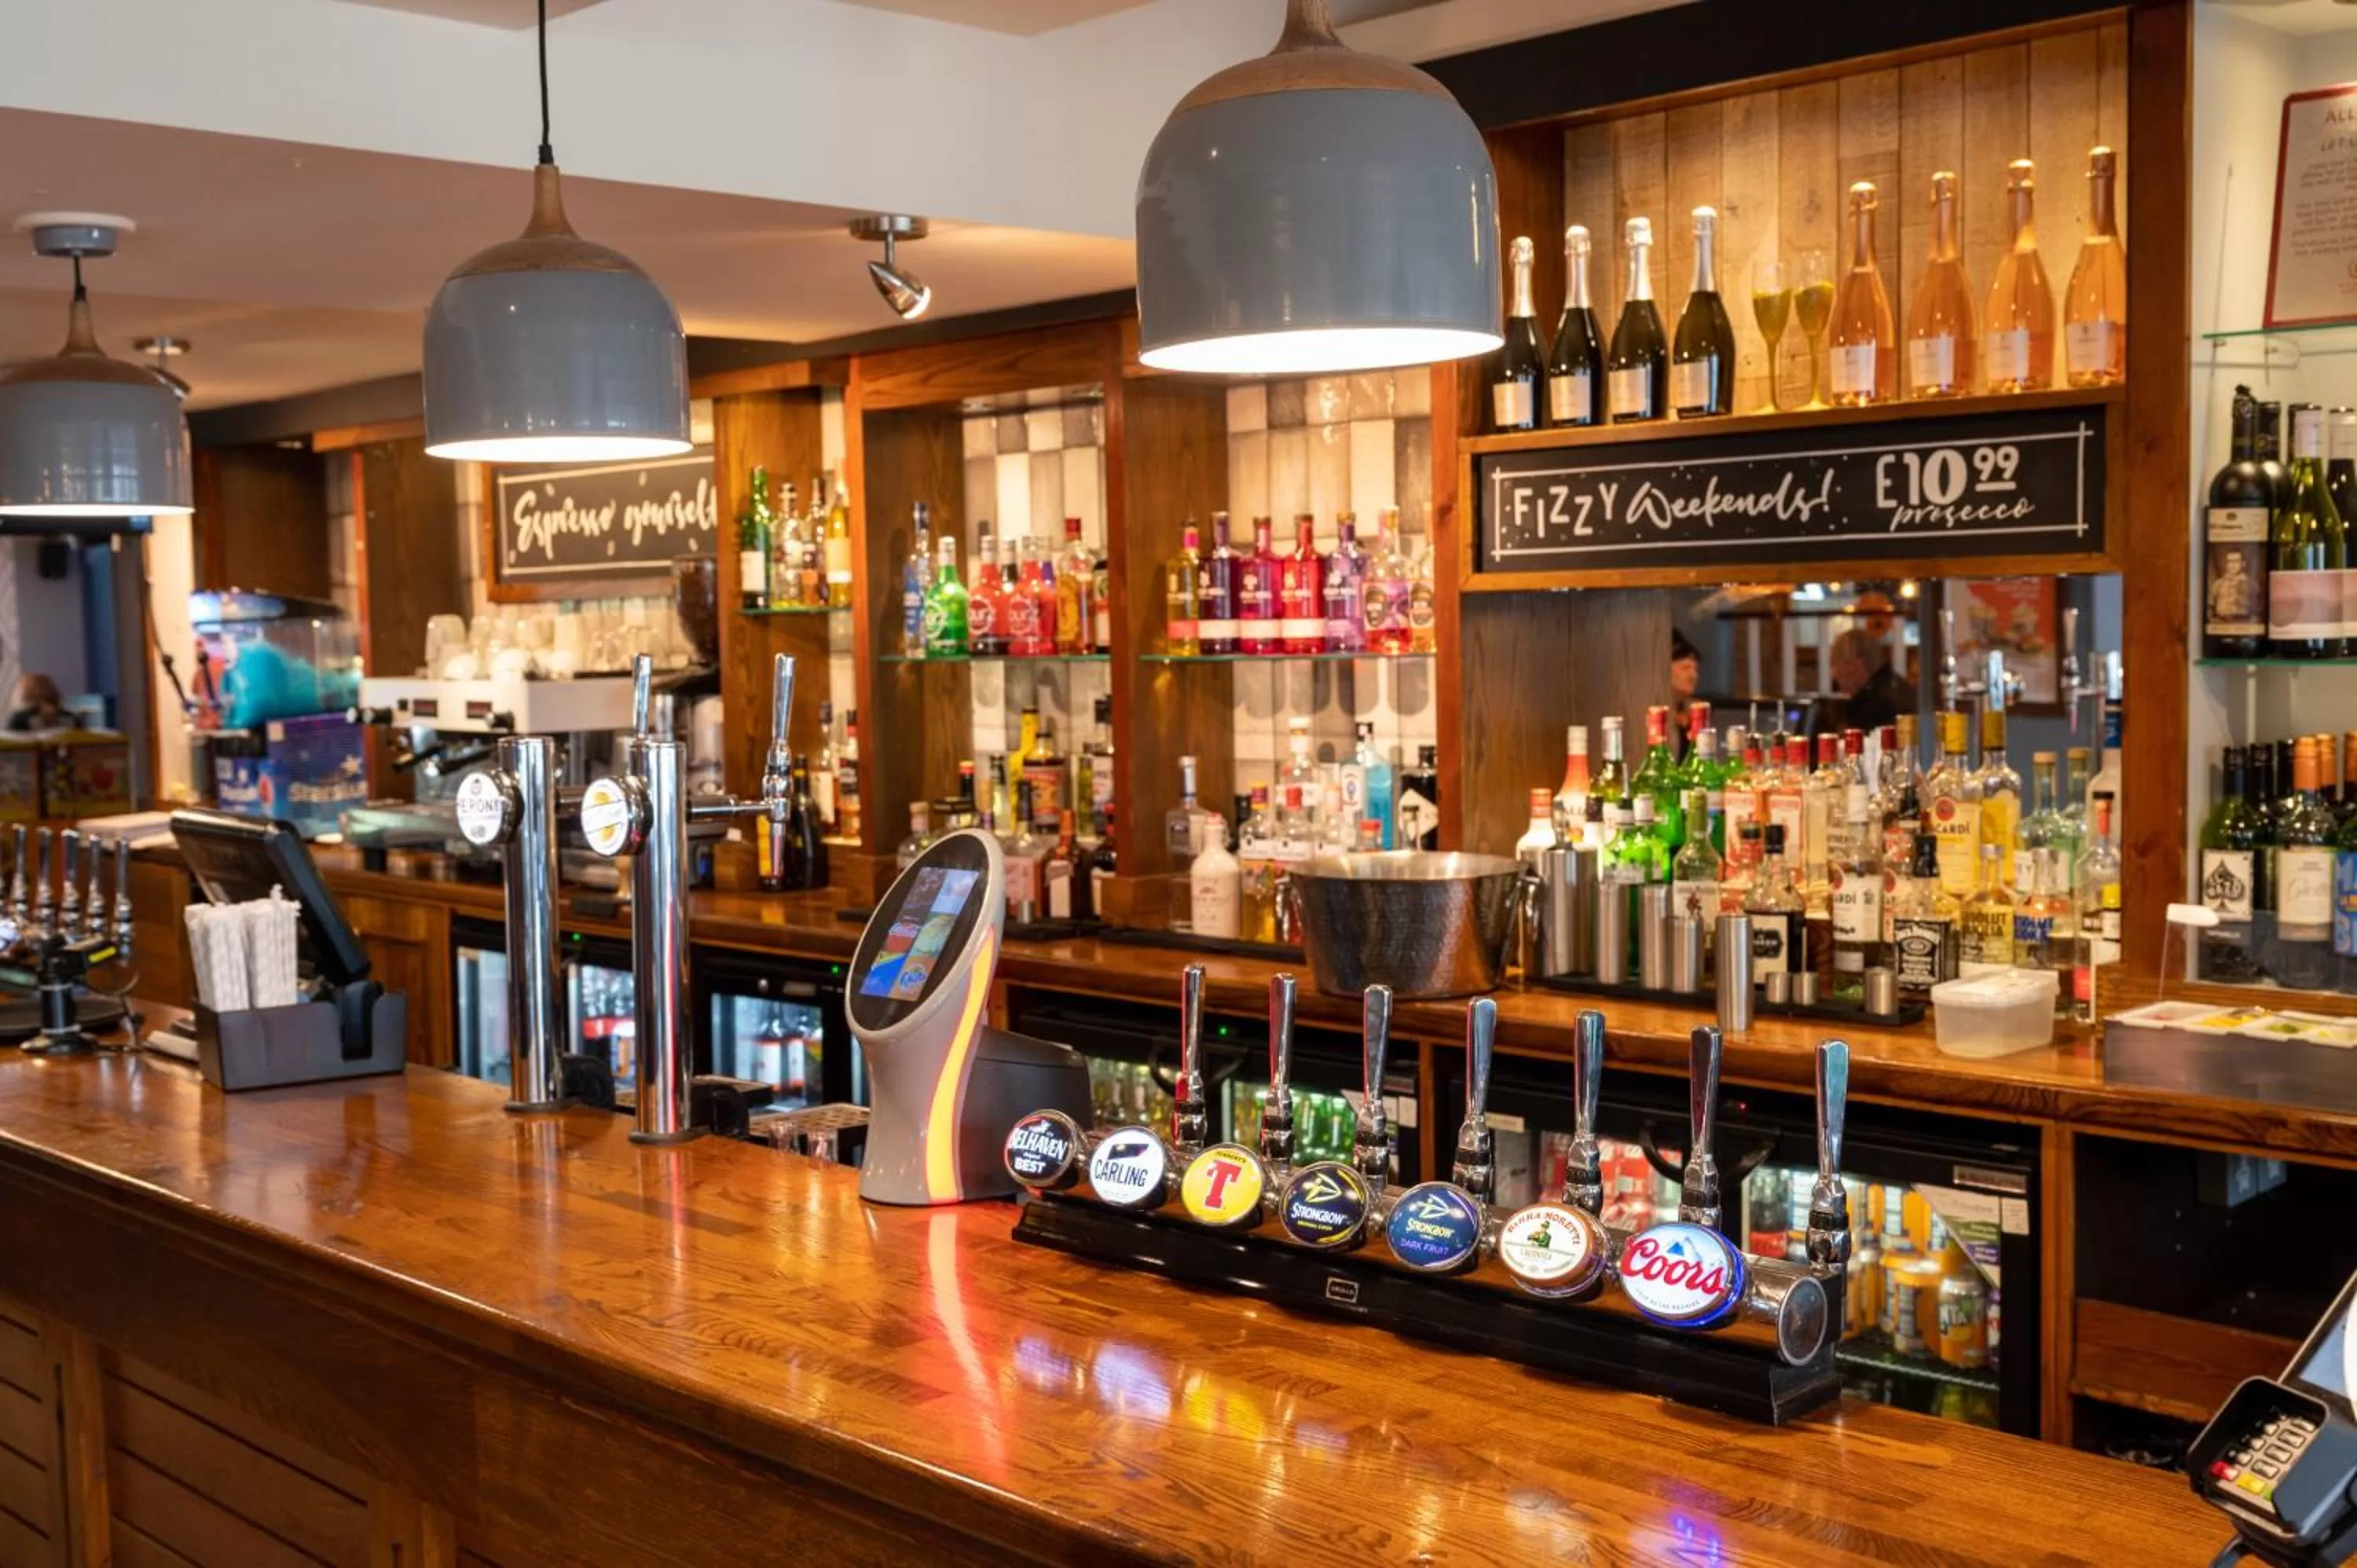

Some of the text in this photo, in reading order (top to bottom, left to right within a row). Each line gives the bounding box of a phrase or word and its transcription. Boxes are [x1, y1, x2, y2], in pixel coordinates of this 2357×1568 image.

[513, 489, 617, 560] Espresso
[1513, 482, 1618, 539] FIZZY
[1626, 467, 1835, 529] Weekends!
[1889, 496, 2036, 532] prosecco
[1014, 1156, 1047, 1174] BEST
[1094, 1159, 1149, 1188] CARLING
[1204, 1159, 1242, 1209] T
[1291, 1202, 1344, 1225] STRONGBOW
[1621, 1236, 1726, 1296] Coors
